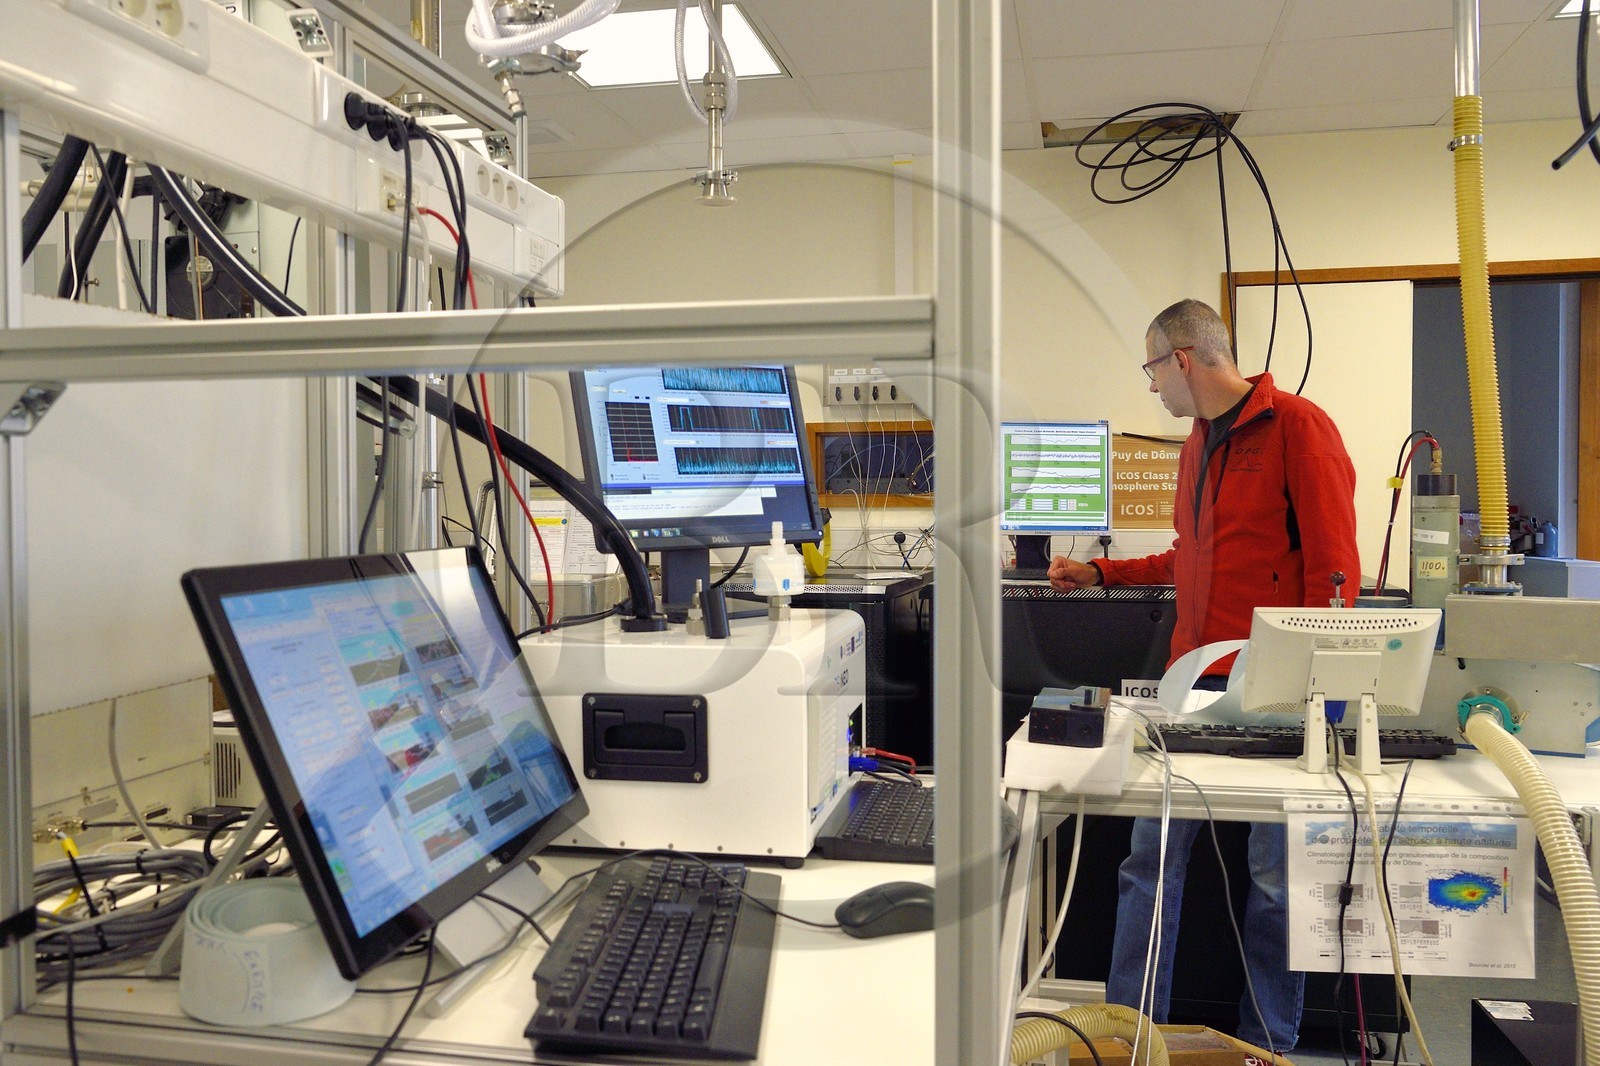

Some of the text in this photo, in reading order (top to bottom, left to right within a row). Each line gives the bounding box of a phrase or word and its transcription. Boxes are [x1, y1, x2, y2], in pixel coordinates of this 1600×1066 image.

[1112, 451, 1131, 462] Puy
[1134, 450, 1148, 460] de
[1116, 471, 1178, 480] ICOS Class 2
[1121, 504, 1154, 516] ICOS
[712, 535, 730, 544] DELL
[1408, 825, 1458, 834] temporelle
[1445, 837, 1472, 846] haute
[1474, 838, 1511, 848] altitude
[1469, 853, 1509, 861] composition
